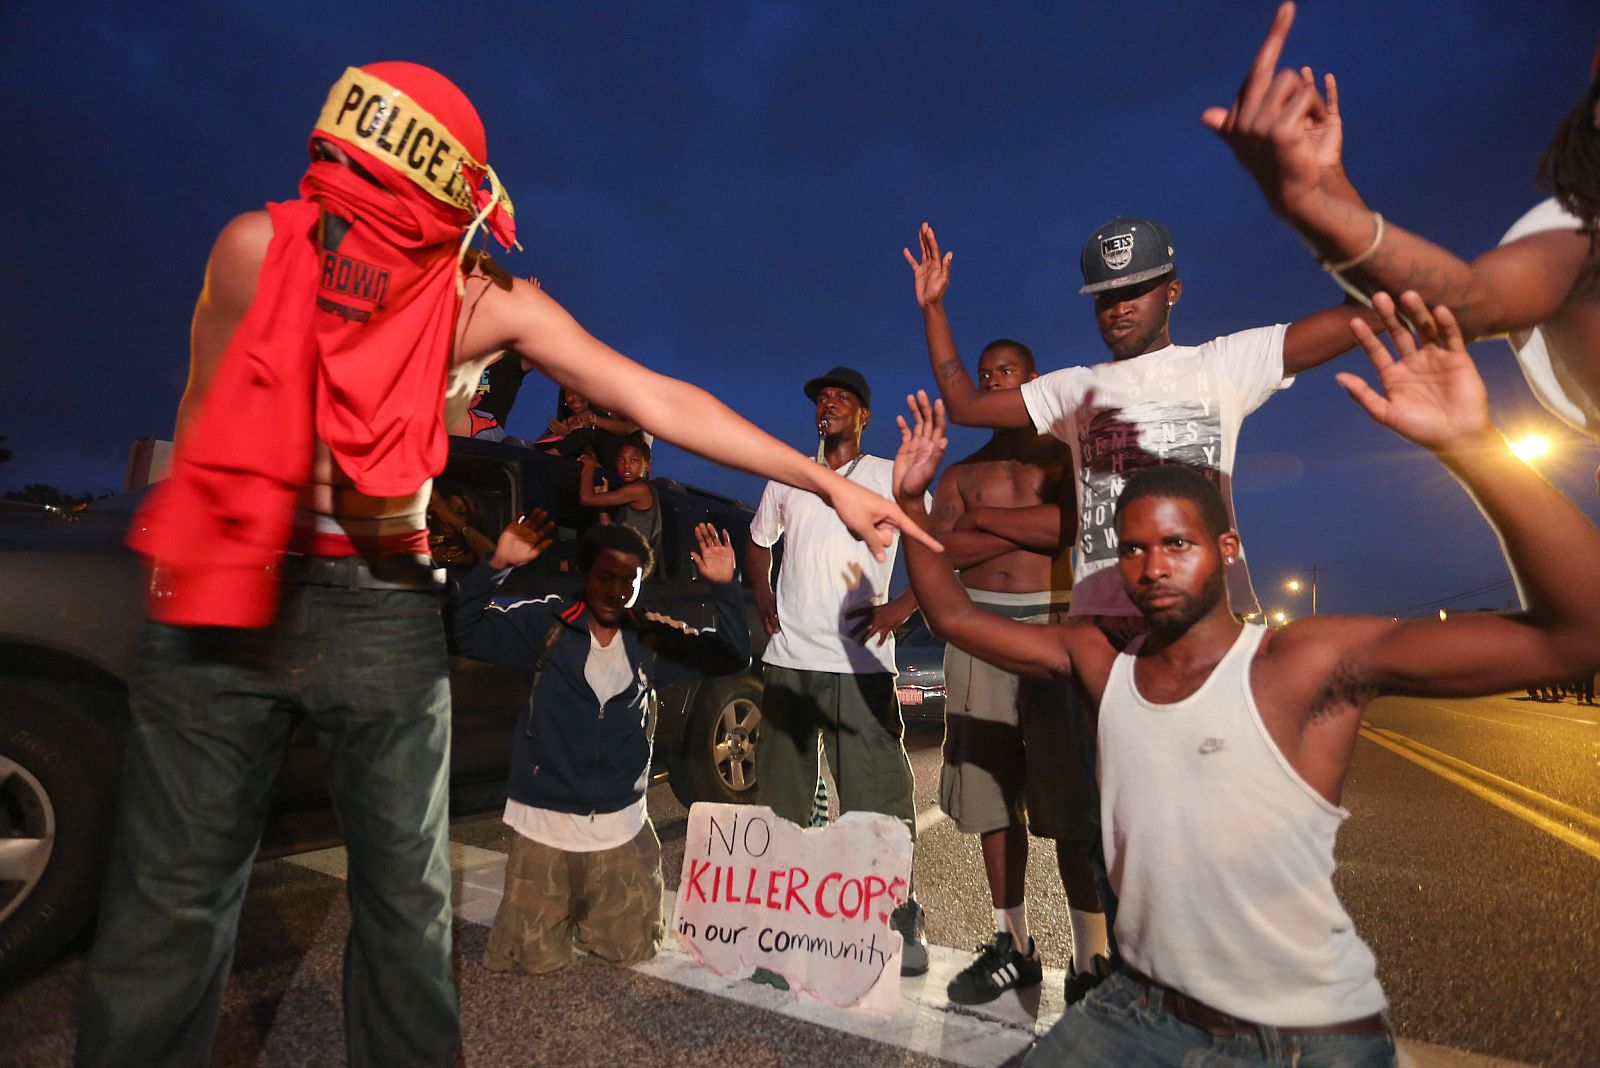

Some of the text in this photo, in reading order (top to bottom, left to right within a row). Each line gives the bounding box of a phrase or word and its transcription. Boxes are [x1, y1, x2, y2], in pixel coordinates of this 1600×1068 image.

[336, 83, 452, 184] POLICE
[1102, 235, 1132, 256] NETS
[321, 253, 391, 312] ROWN
[707, 813, 770, 858] NO
[685, 858, 811, 915] KILLER
[678, 916, 893, 970] in our community
